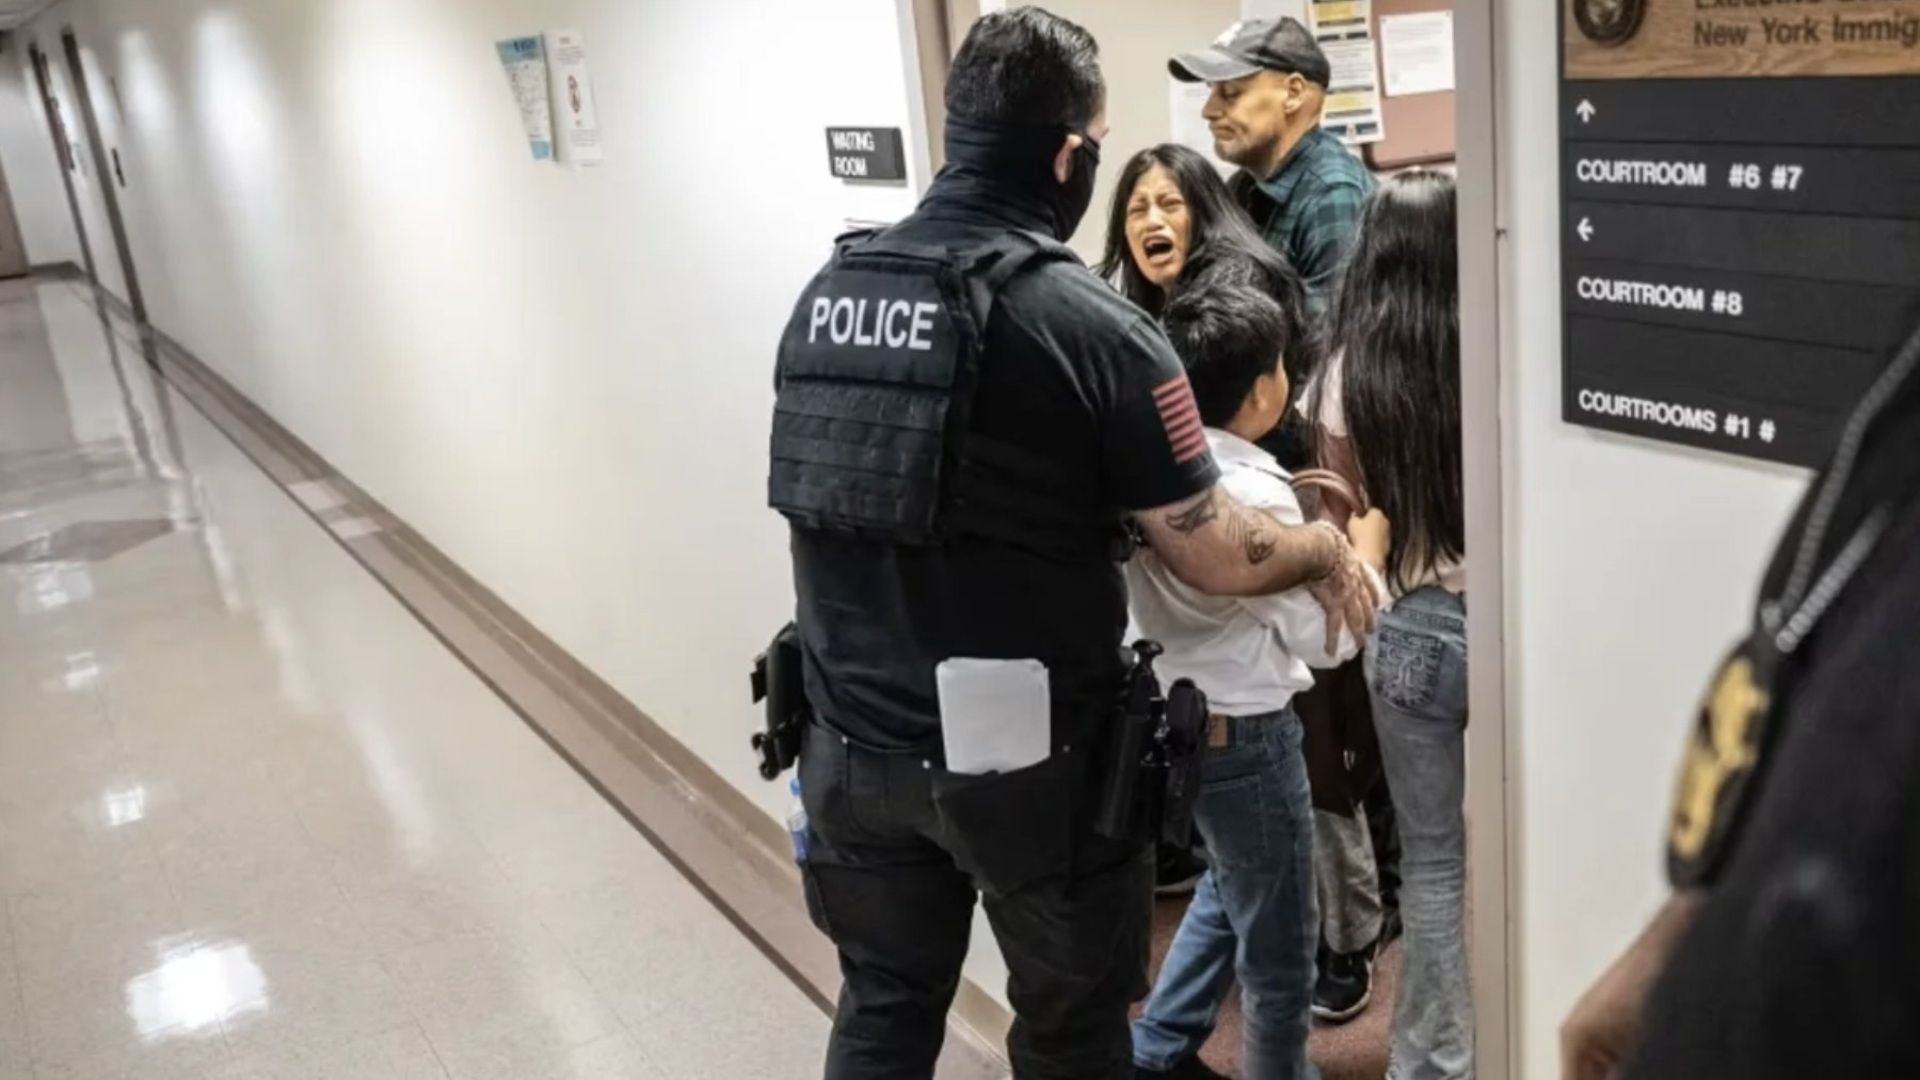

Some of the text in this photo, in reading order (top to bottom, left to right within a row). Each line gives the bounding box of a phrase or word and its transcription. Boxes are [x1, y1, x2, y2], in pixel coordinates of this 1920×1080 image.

[1693, 21, 1748, 47] New
[1761, 17, 1821, 45] York
[831, 131, 876, 151] WAITING
[834, 156, 868, 176] ROOM
[1576, 159, 1803, 190] COURTROOM #6 #7
[1577, 276, 1743, 315] COURTROOM #8
[808, 297, 938, 350] POLICE
[1578, 389, 1717, 433] COURTROOMS
[1724, 413, 1750, 438] #1
